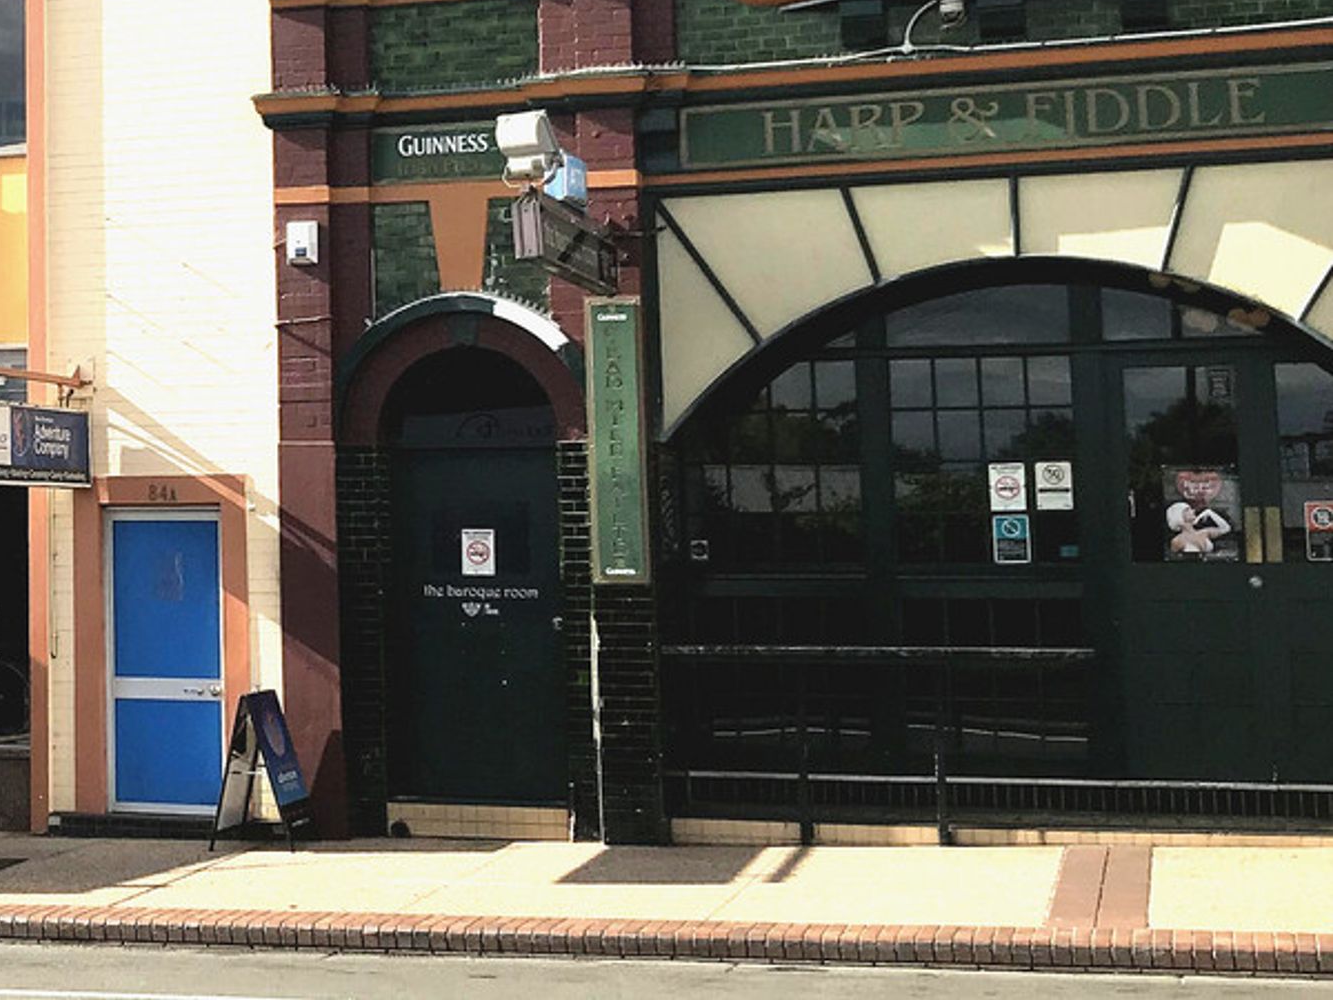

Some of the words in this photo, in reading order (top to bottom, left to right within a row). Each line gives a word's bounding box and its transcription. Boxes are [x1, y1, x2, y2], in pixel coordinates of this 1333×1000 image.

[764, 100, 926, 155] HARP
[949, 98, 998, 143] &
[1025, 77, 1267, 142] FIDDLE
[398, 132, 490, 157] GUINNESS
